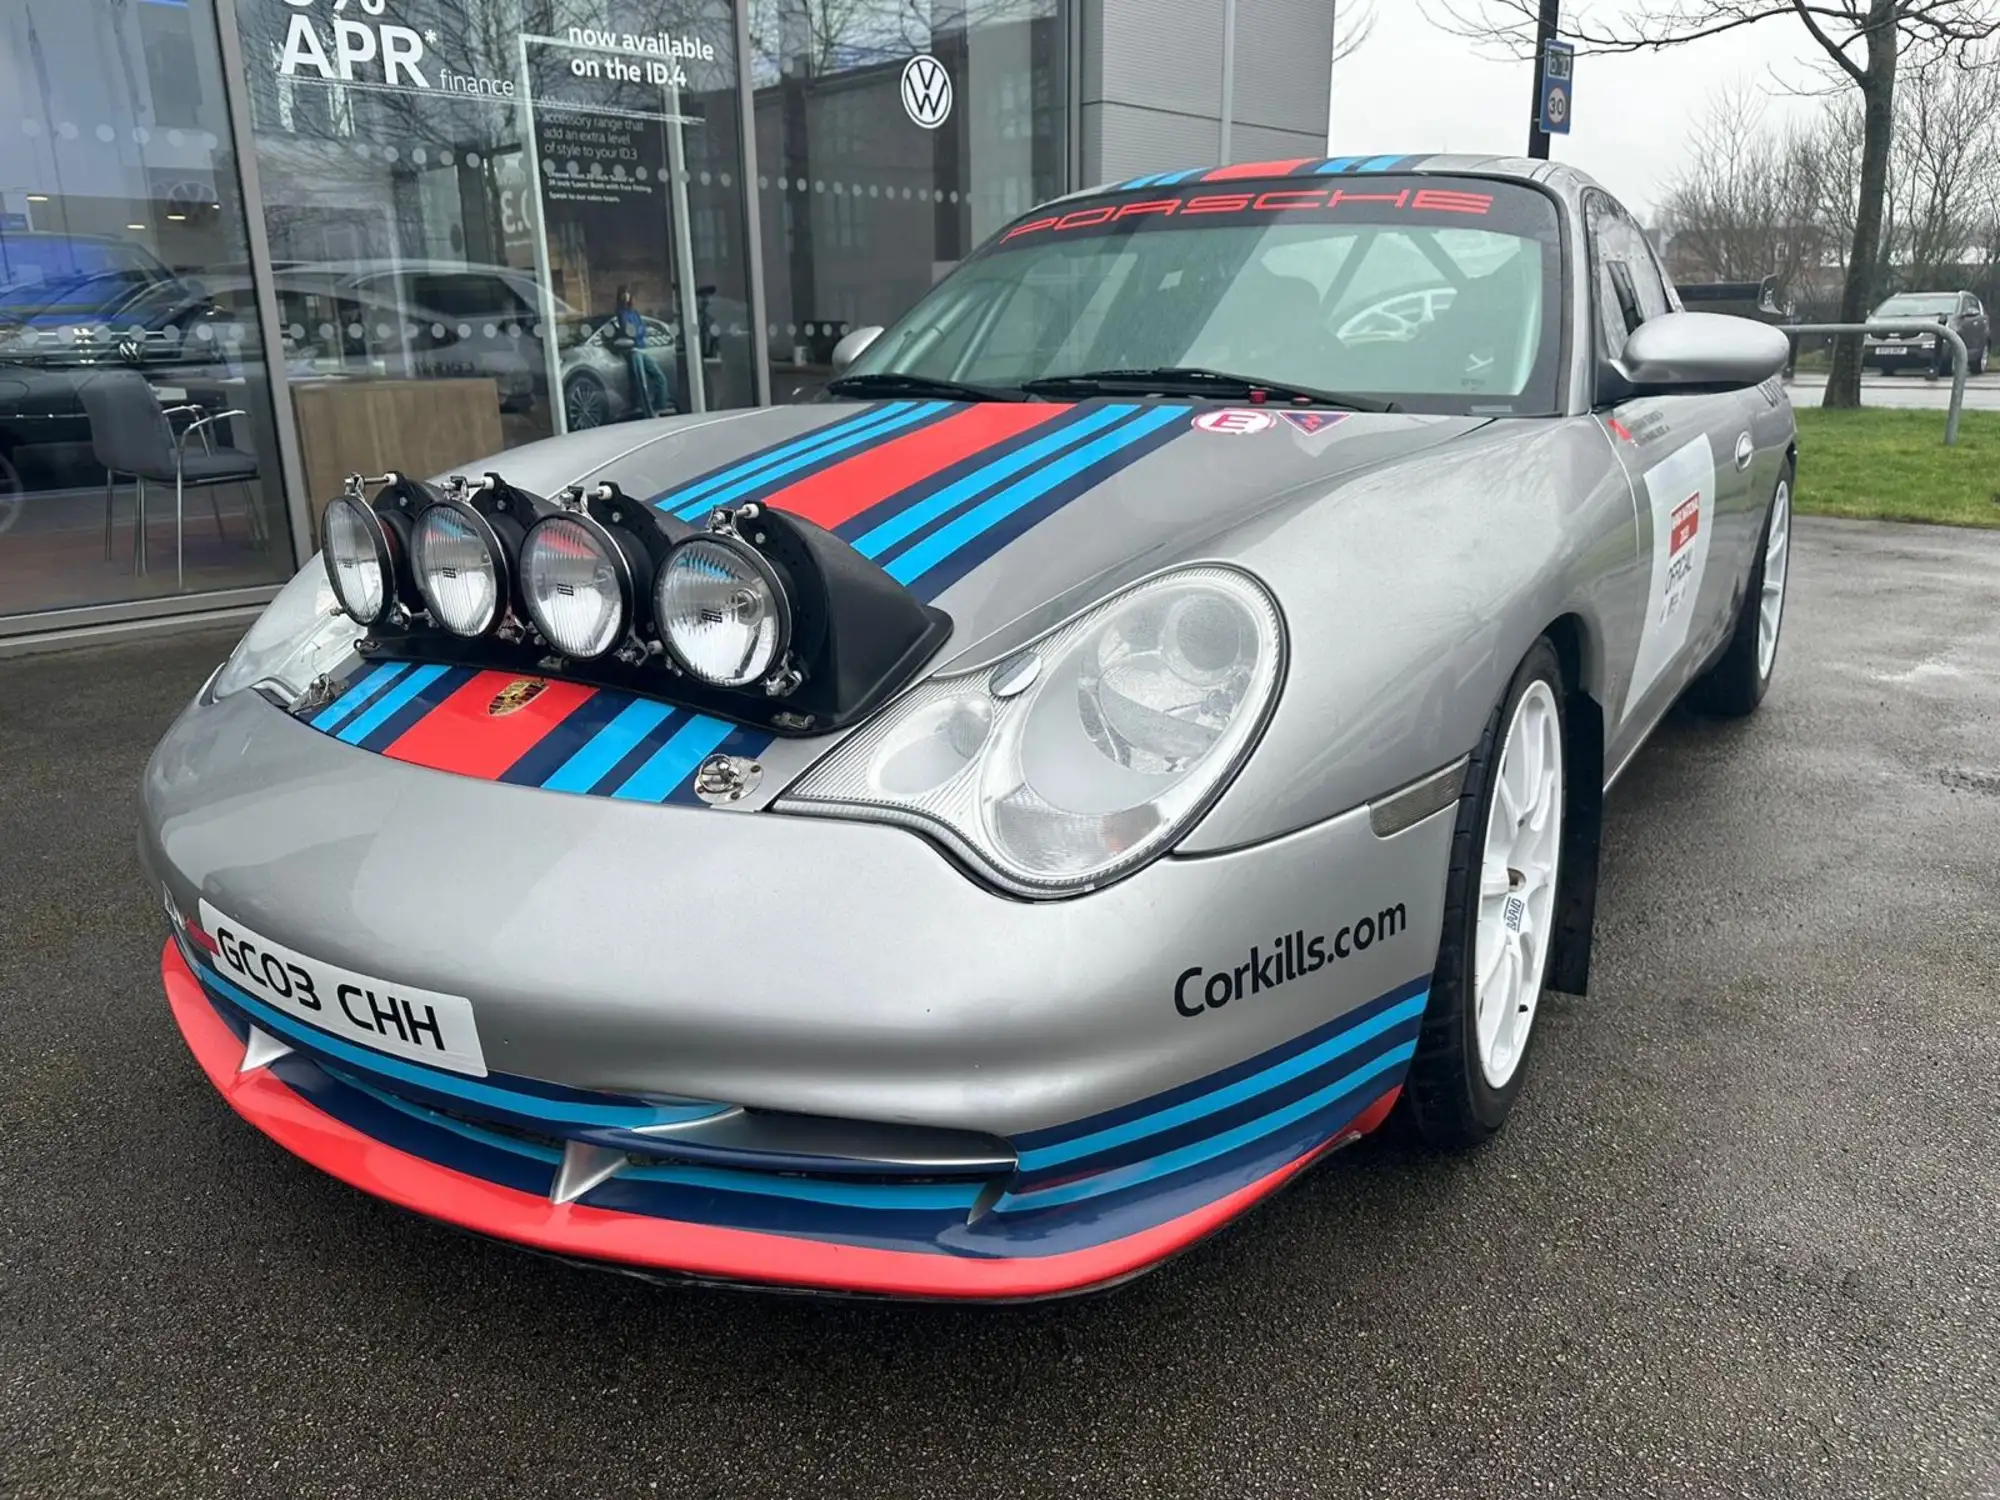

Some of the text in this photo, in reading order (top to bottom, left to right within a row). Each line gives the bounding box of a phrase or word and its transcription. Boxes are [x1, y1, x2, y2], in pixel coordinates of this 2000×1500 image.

[569, 27, 714, 61] now available
[439, 69, 514, 96] finance
[571, 57, 687, 87] on the ID.4
[1549, 97, 1565, 115] 30
[543, 127, 631, 144] add an extra level
[593, 117, 623, 131] range
[624, 119, 644, 131] that
[544, 142, 555, 153] of
[557, 144, 580, 158] style
[582, 145, 593, 157] to
[595, 149, 617, 159] your
[1000, 188, 1494, 245] PORSCHE
[1174, 902, 1407, 1018] Corkills.com
[336, 983, 446, 1051] CHH
